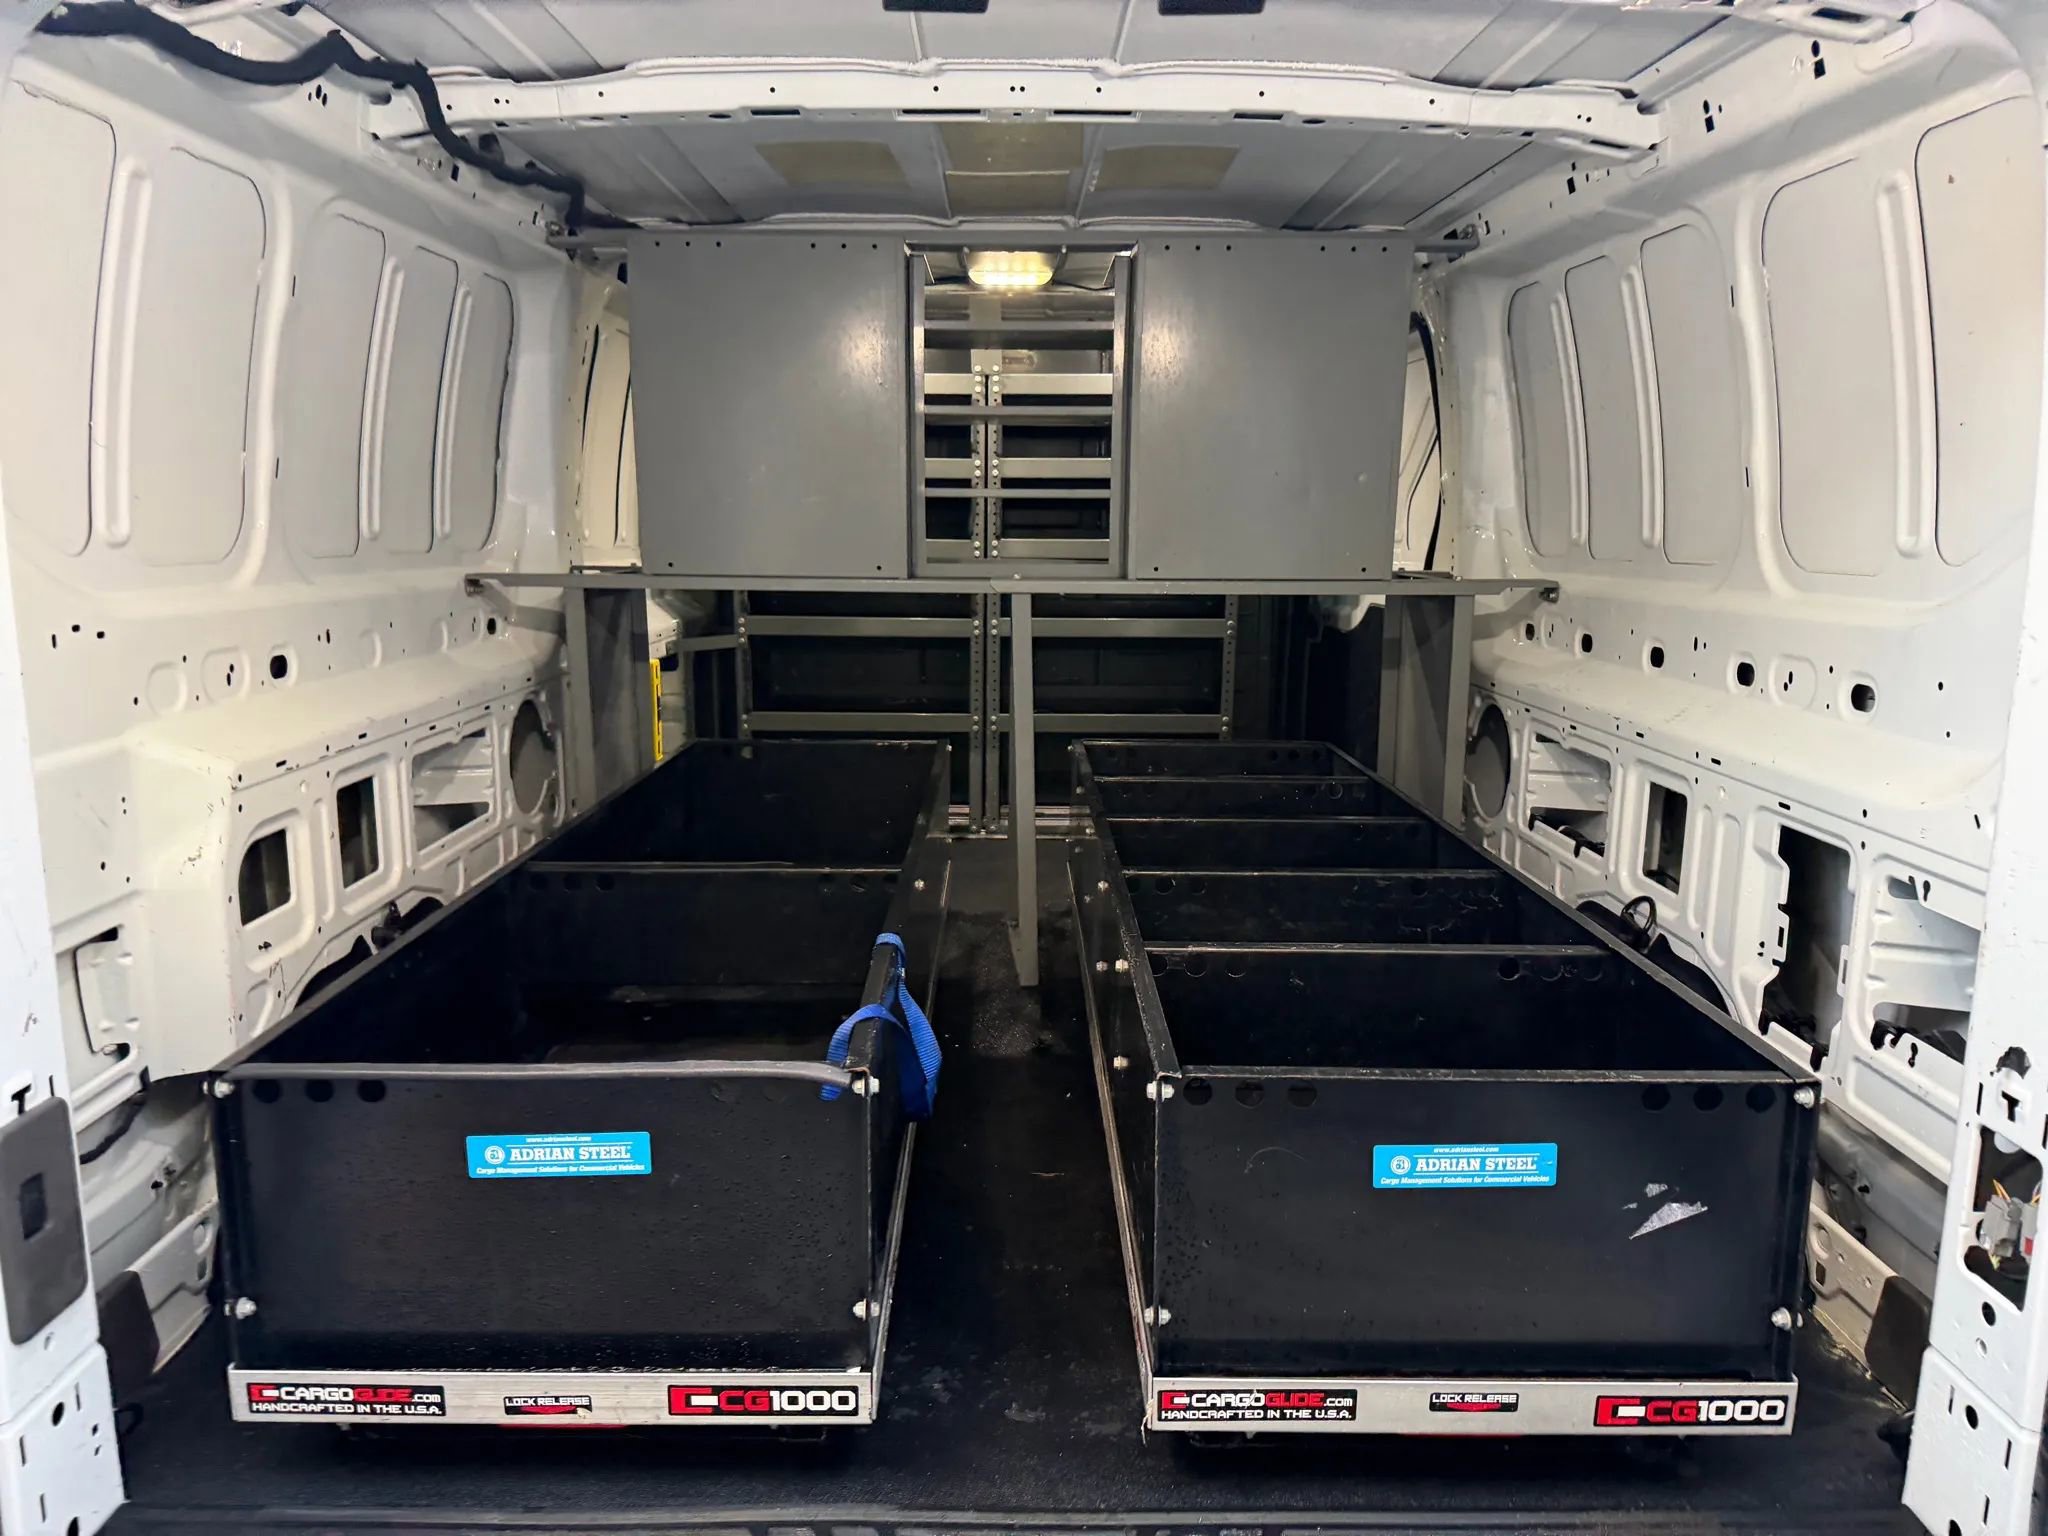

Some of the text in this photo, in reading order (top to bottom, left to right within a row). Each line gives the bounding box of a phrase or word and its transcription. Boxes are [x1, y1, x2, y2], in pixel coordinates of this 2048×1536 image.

[510, 1146, 631, 1161] ADRIAN STEEL
[1416, 1157, 1537, 1171] ADRIAN STEEL
[1381, 1177, 1400, 1185] Cargo
[1401, 1176, 1442, 1184] Management
[1484, 1175, 1522, 1183] Commercial
[505, 1397, 590, 1406] LOCK RELEASE
[1432, 1394, 1517, 1403] LOCK RELEASE
[252, 1403, 442, 1415] HANDCRAFTED IN THE U.S.A.
[1161, 1410, 1352, 1419] HANDCRAFTED IN THE U.S.A.
